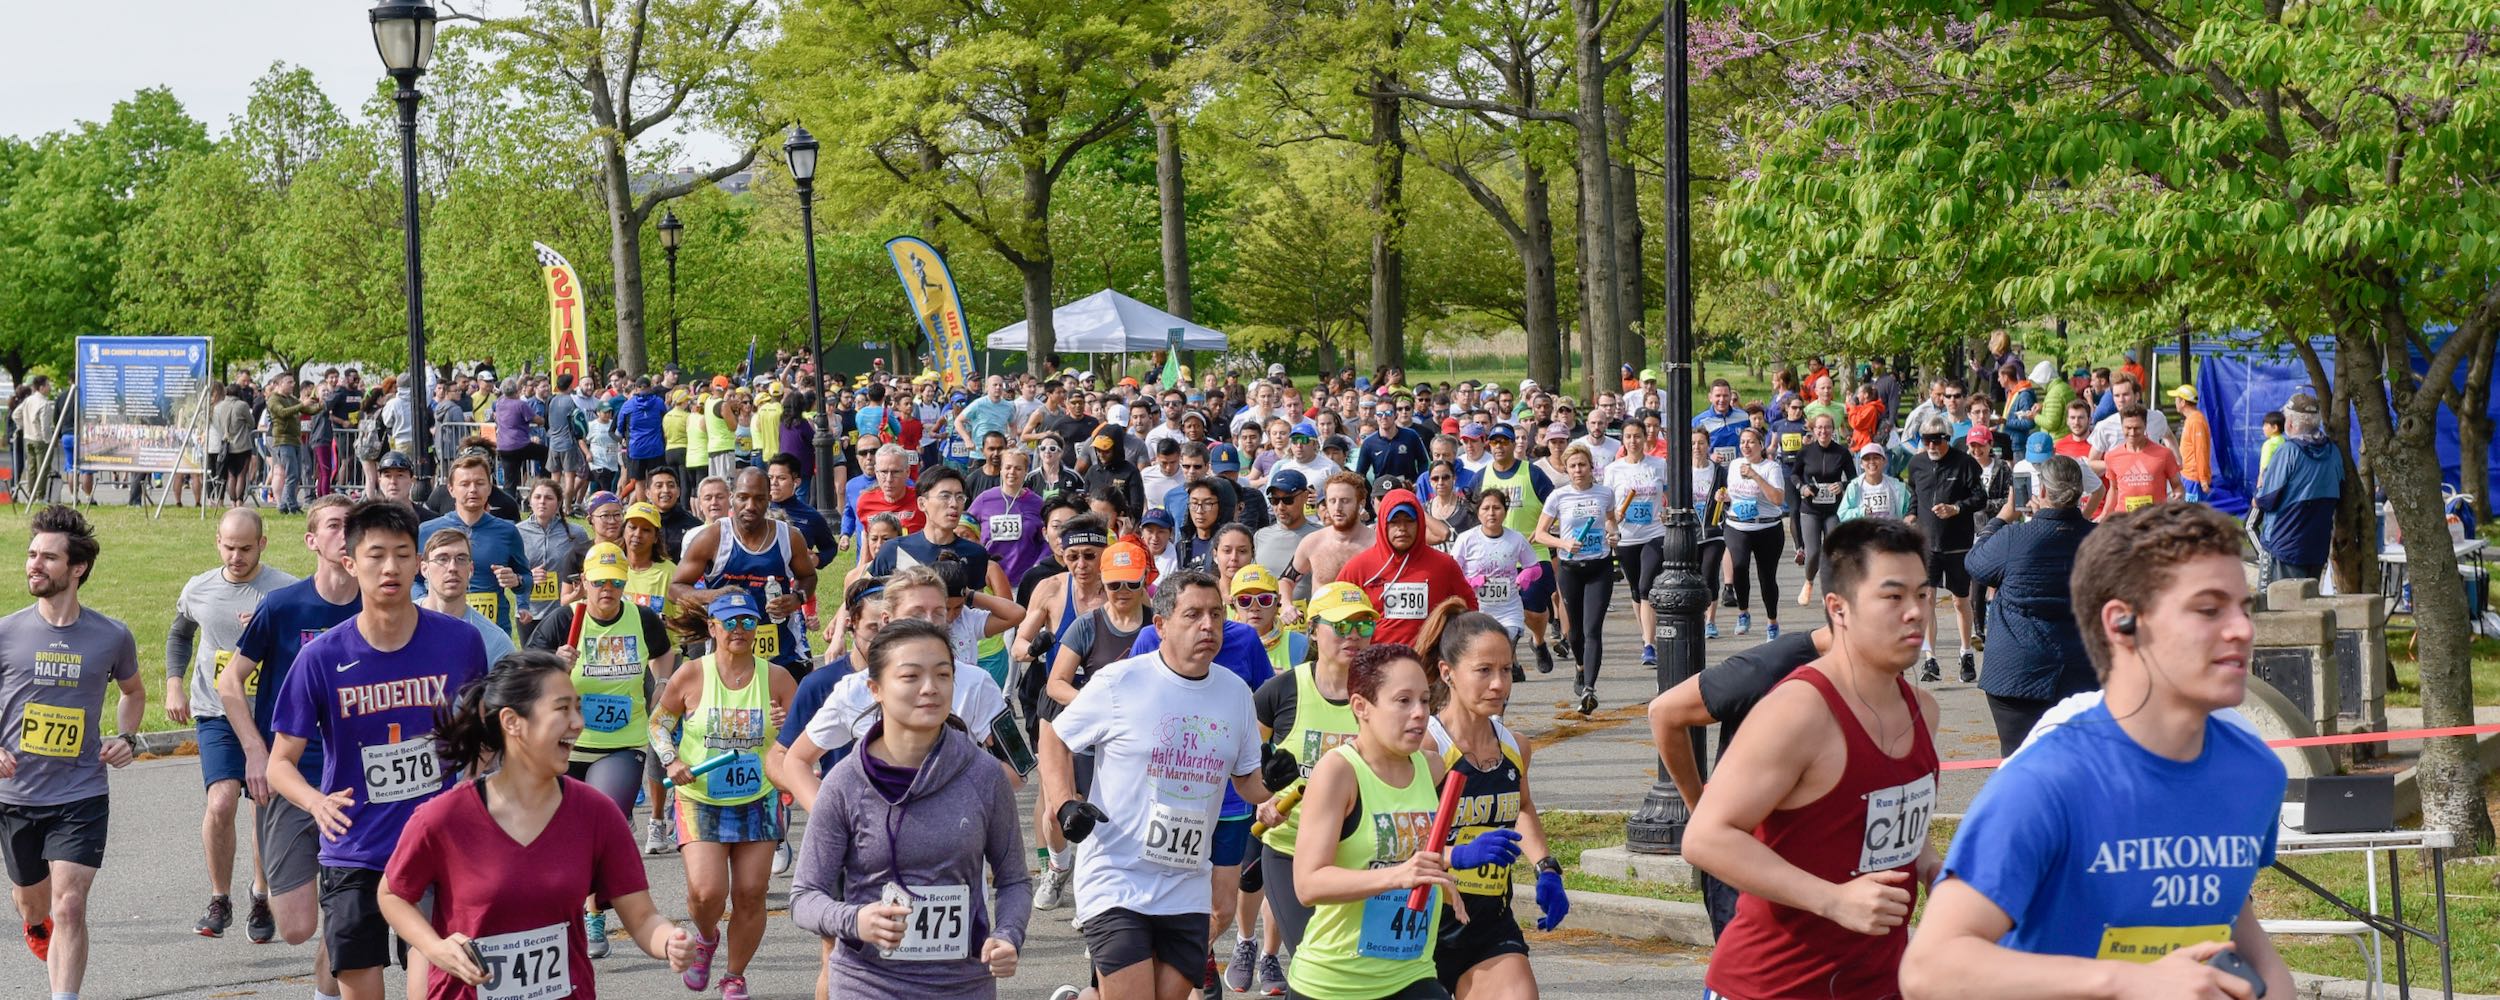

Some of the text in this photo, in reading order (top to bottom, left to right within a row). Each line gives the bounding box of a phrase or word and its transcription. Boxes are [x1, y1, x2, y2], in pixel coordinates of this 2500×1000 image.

[946, 311, 960, 337] run
[2122, 472, 2154, 482] adidas
[35, 651, 82, 664] BROOKLYN
[34, 662, 67, 677] HALF
[337, 674, 449, 719] PHOENIX
[595, 704, 629, 724] 25A
[1182, 732, 1198, 750] 5K
[1151, 747, 1225, 771] Half Marathon
[725, 767, 760, 787] 46A
[1146, 763, 1164, 779] Half
[1165, 766, 1205, 782] Marathon
[375, 788, 404, 798] Become
[406, 785, 420, 793] and
[1876, 798, 1893, 808] Run
[1910, 787, 1932, 801] Become
[1452, 794, 1494, 826] FAST
[1183, 816, 1205, 825] Become
[1868, 854, 1899, 866] Become
[2086, 835, 2265, 874] AFIKOMEN
[929, 894, 962, 902] Become
[2151, 873, 2221, 908] 2018
[914, 905, 962, 940] 475
[1390, 907, 1429, 940] 44A
[481, 934, 559, 953] Run and Become
[894, 944, 960, 954] ecome and Run
[1366, 941, 1400, 953] Become
[2110, 941, 2137, 955] Run
[2141, 943, 2167, 956] and
[527, 988, 543, 999] and
[545, 984, 562, 994] Run
